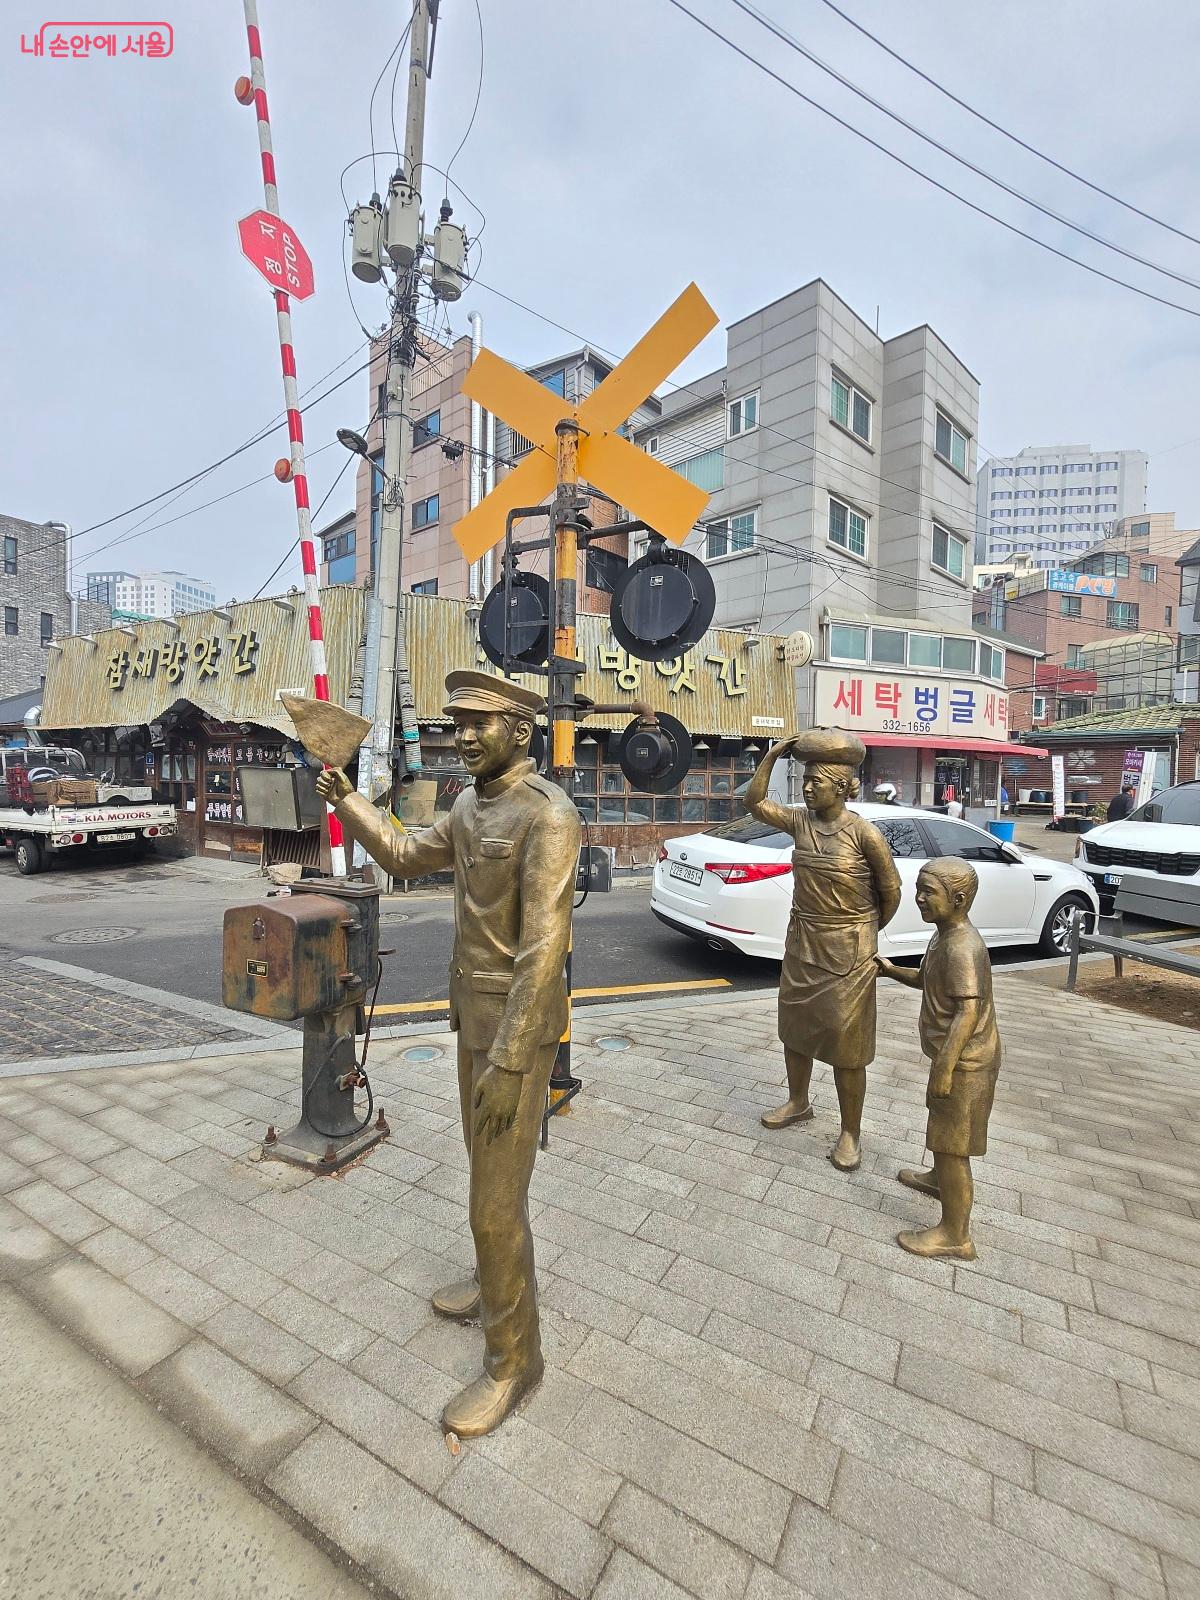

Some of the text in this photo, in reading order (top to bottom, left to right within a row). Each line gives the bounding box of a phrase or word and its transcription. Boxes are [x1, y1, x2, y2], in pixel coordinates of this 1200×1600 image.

[282, 231, 301, 288] STOP
[106, 630, 259, 690] 참새방앗간
[833, 679, 976, 724] 세탁 벙글
[882, 720, 931, 733] 332-1656
[84, 814, 105, 823] KIA
[107, 811, 152, 821] MOTORS
